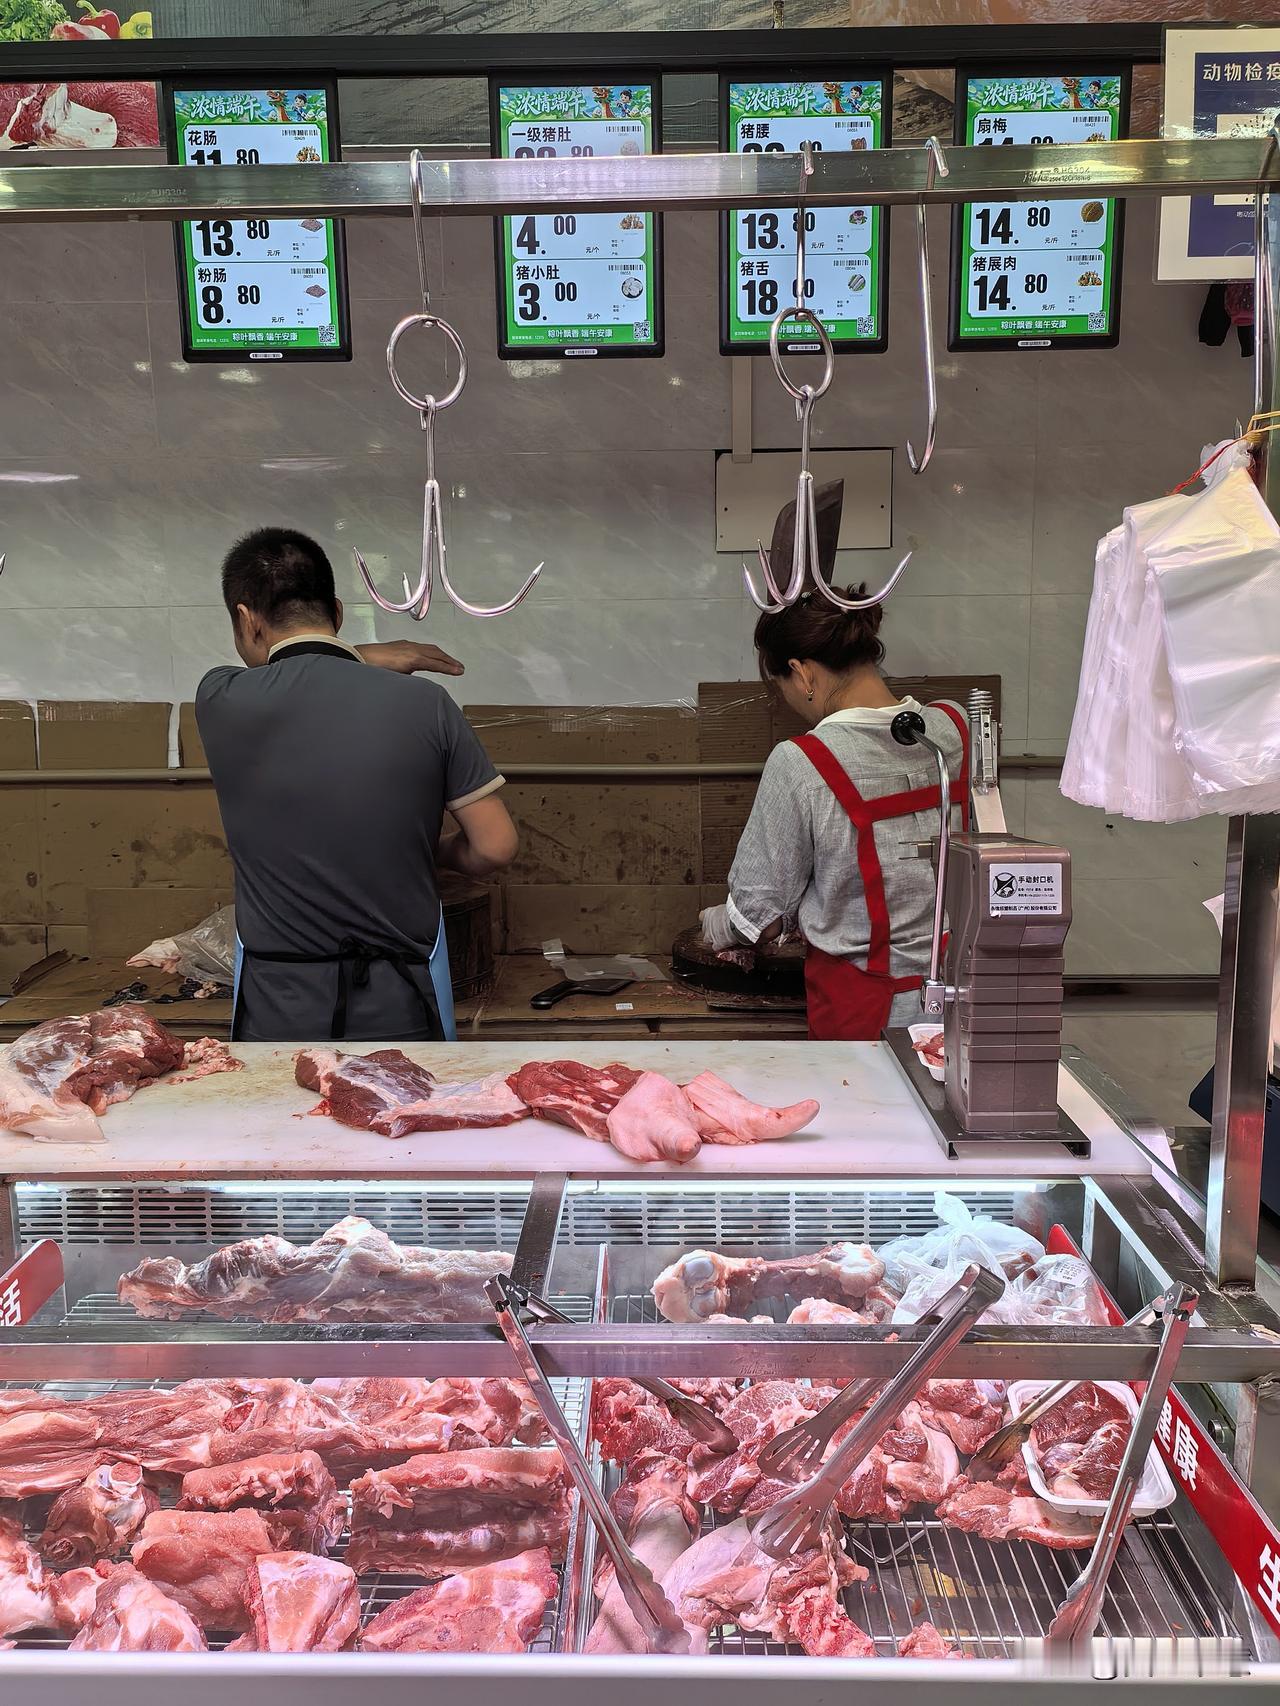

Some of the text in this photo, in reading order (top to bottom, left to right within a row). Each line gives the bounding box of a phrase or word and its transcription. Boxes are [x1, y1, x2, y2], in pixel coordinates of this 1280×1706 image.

[1203, 63, 1280, 81] 动物检疫
[746, 87, 816, 113] 浓情端午
[983, 82, 1054, 107] 浓情端午
[190, 94, 262, 121] 浓情端午
[515, 91, 586, 117] 浓情端午
[512, 126, 571, 142] 一级猪肚
[741, 123, 770, 139] 猪腰
[977, 118, 1007, 134] 扇梅
[188, 130, 217, 146] 花肠
[553, 215, 576, 235] 00
[1027, 207, 1051, 227] 80
[247, 220, 270, 240] 80
[741, 261, 769, 276] 猪舌
[973, 256, 1016, 272] 猪展肉
[198, 268, 227, 283] 粉肠
[516, 265, 560, 280] 猪小肚
[555, 282, 577, 302] 00
[1025, 274, 1048, 294] 80
[237, 285, 261, 305] 80
[742, 279, 778, 315] 18
[778, 324, 802, 334] 叶飘香
[1035, 320, 1067, 329] 端午安康
[266, 332, 298, 341] 端午安康
[581, 328, 613, 338] 端午安康
[1018, 876, 1054, 884] 手动封口机
